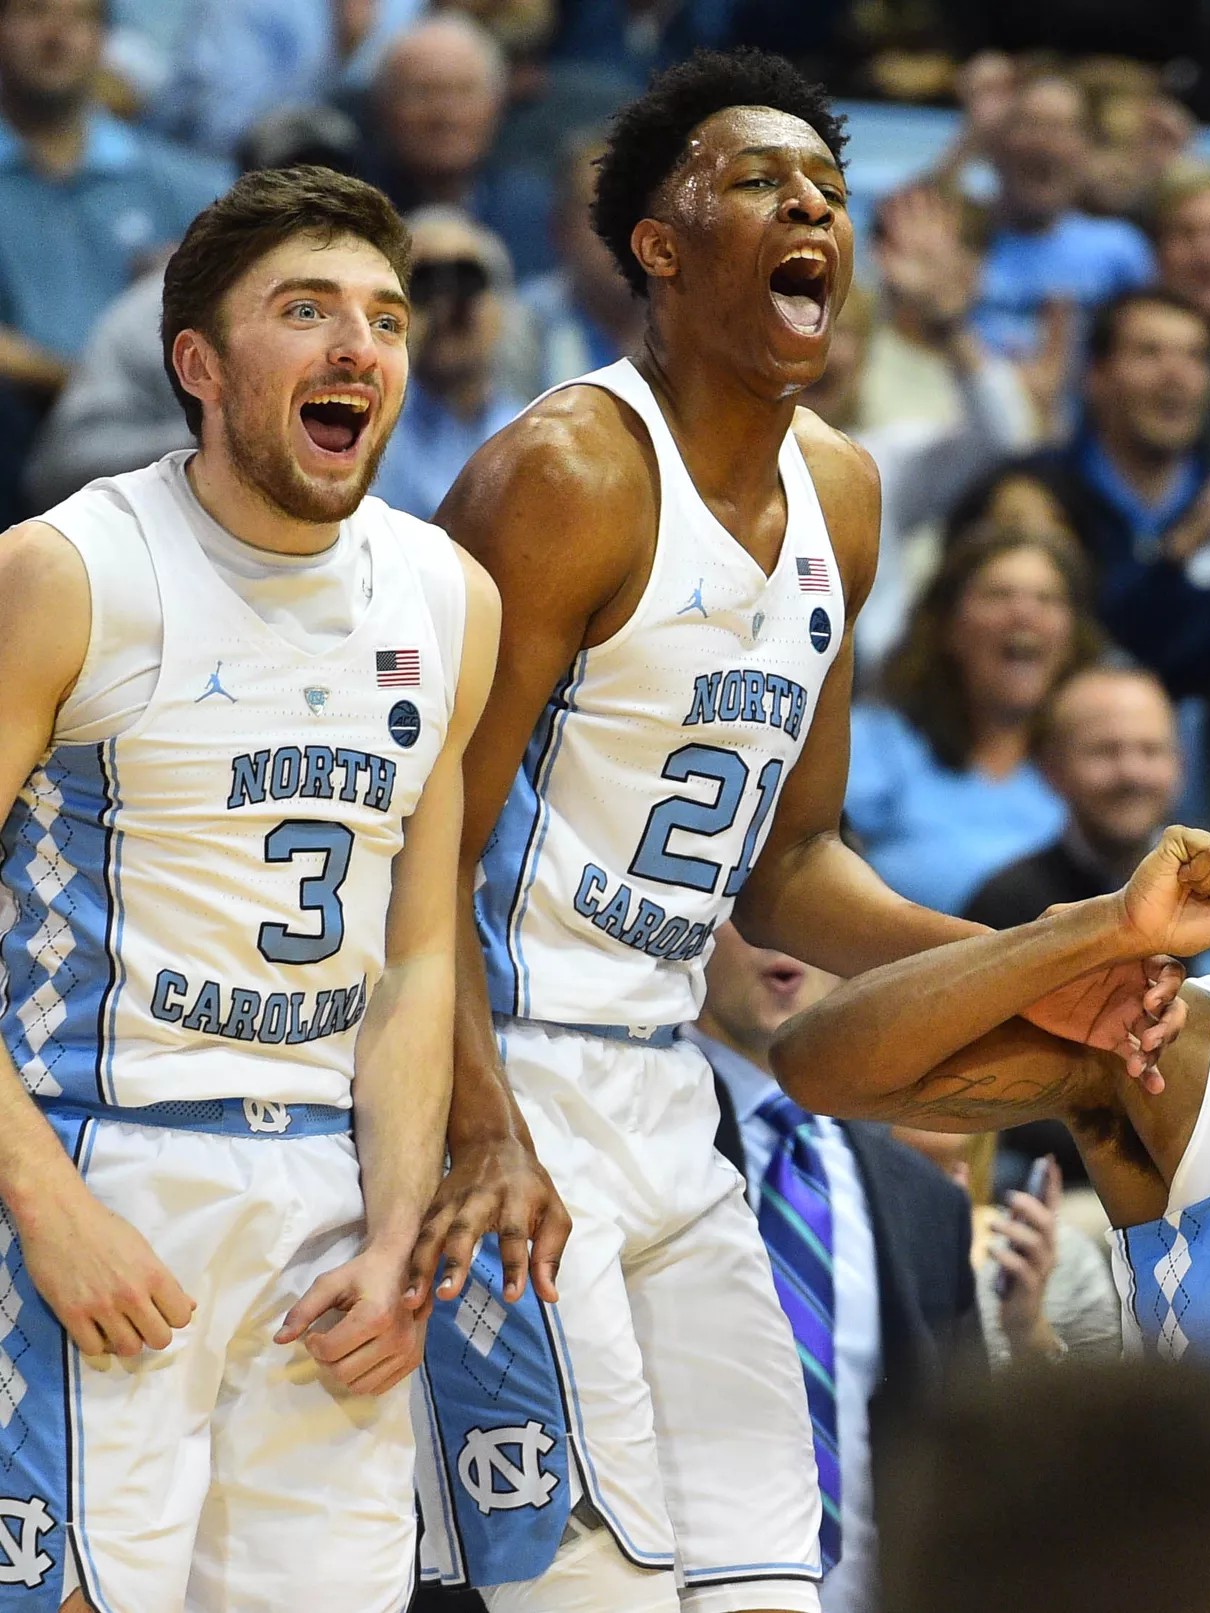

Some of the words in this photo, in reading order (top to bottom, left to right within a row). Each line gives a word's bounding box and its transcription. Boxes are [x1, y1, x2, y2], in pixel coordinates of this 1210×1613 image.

[682, 669, 808, 741] NORTH
[228, 746, 396, 811] NORTH
[627, 742, 784, 897] 21
[257, 819, 355, 965] 3
